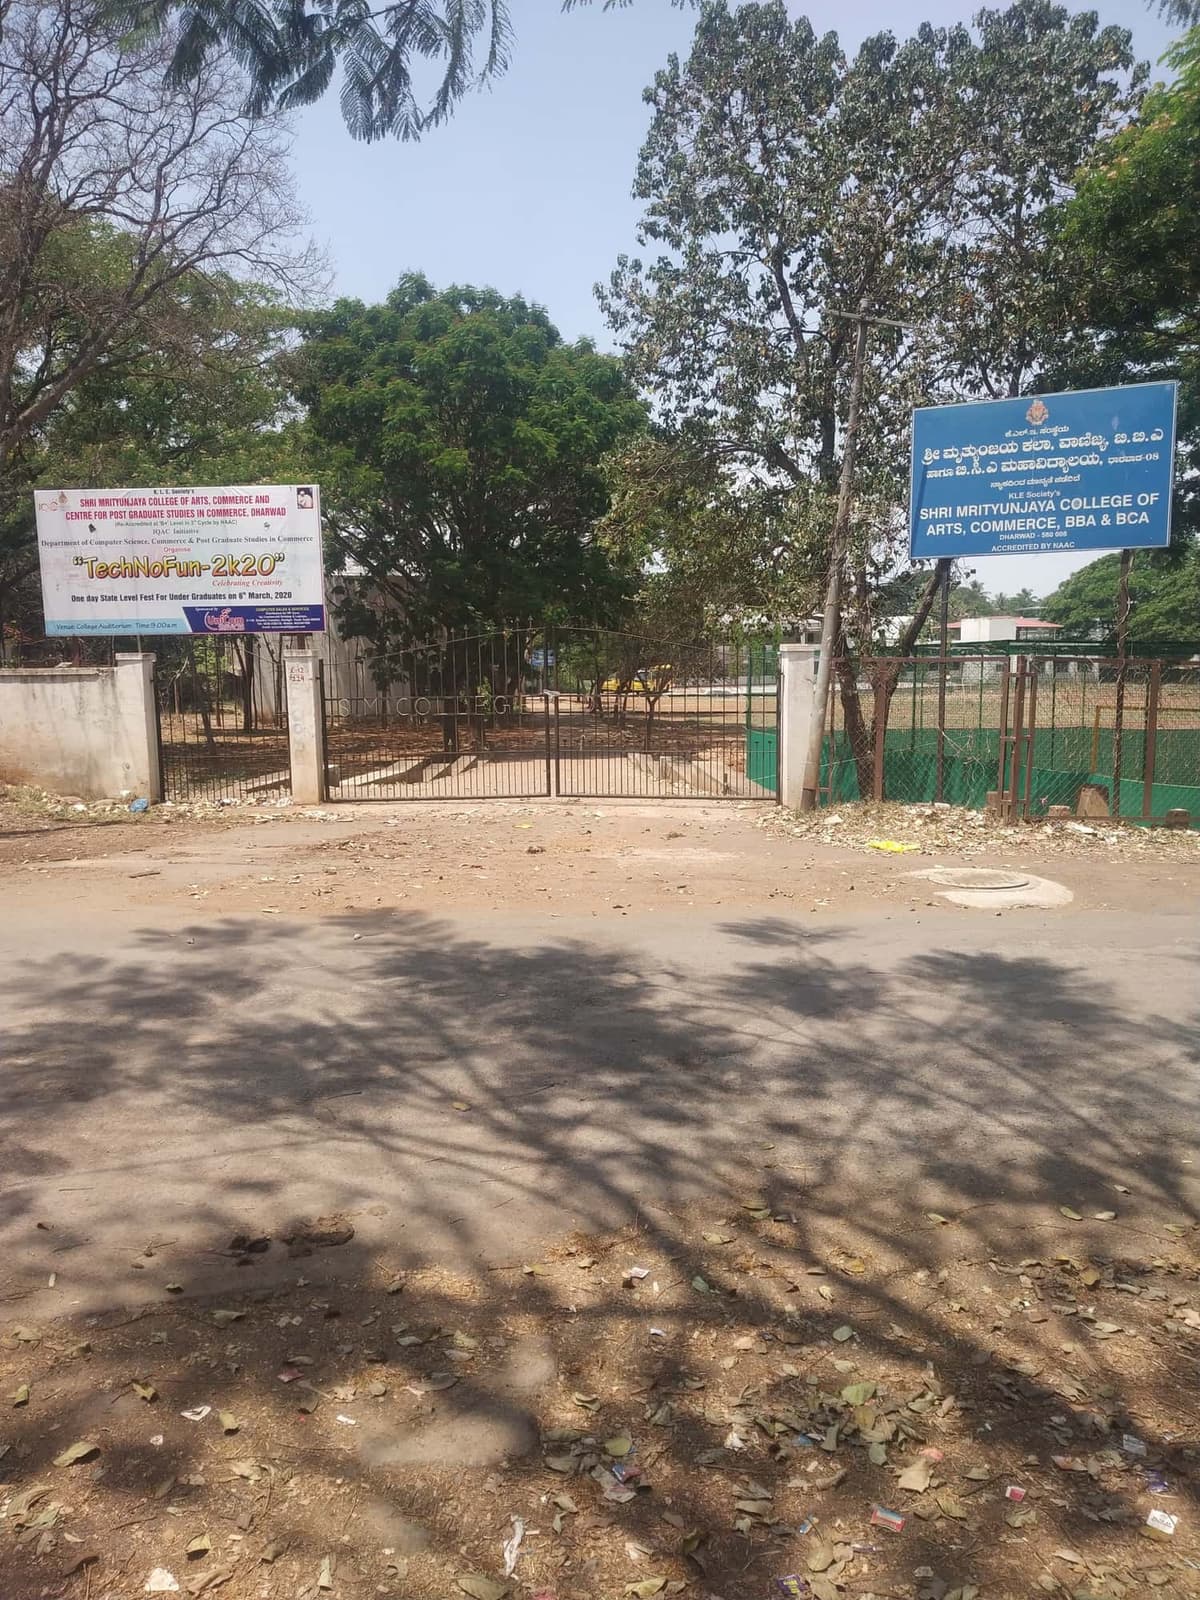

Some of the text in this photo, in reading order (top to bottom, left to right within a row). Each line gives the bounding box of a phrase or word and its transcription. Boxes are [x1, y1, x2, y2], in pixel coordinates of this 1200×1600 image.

[921, 448, 940, 465] ಶ್ರೀ
[943, 441, 1019, 464] ಮೃತ್ಯುಂಜಯ
[926, 467, 953, 479] ಹಾಗೂ
[1008, 489, 1060, 500] KLE Society's
[80, 495, 270, 508] SHRI MRITYUNJAYA COLLEGE OF ARTS, COMMERCE AND
[920, 493, 1160, 520] SHRI MRITYUNJAYA COLLEGE OF
[65, 507, 286, 520] CENTRE FOR POST GRADUATE STUDIES IN COMMERCE, DHARWAD
[926, 511, 1150, 536] ARTS, COMMERCE, BBA & BCA
[41, 539, 79, 548] Department
[90, 539, 122, 547] Computer
[151, 537, 187, 545] Commerce
[212, 536, 241, 544] Graduate
[244, 535, 268, 543] Studies
[277, 535, 313, 543] Commerce
[1000, 532, 1036, 541] DHARWAD
[1042, 531, 1054, 539] 580
[1055, 530, 1068, 538] 008
[991, 541, 1075, 552] ACCREDITED BY NAAC
[212, 579, 283, 588] Celebrating Creativity
[86, 594, 99, 603] day
[100, 594, 118, 602] State
[120, 594, 138, 602] Level
[140, 593, 154, 601] Fest
[169, 593, 189, 601] Under
[191, 592, 227, 600] Graduates
[248, 591, 273, 600] March,
[275, 591, 292, 599] 2020
[76, 623, 98, 631] College
